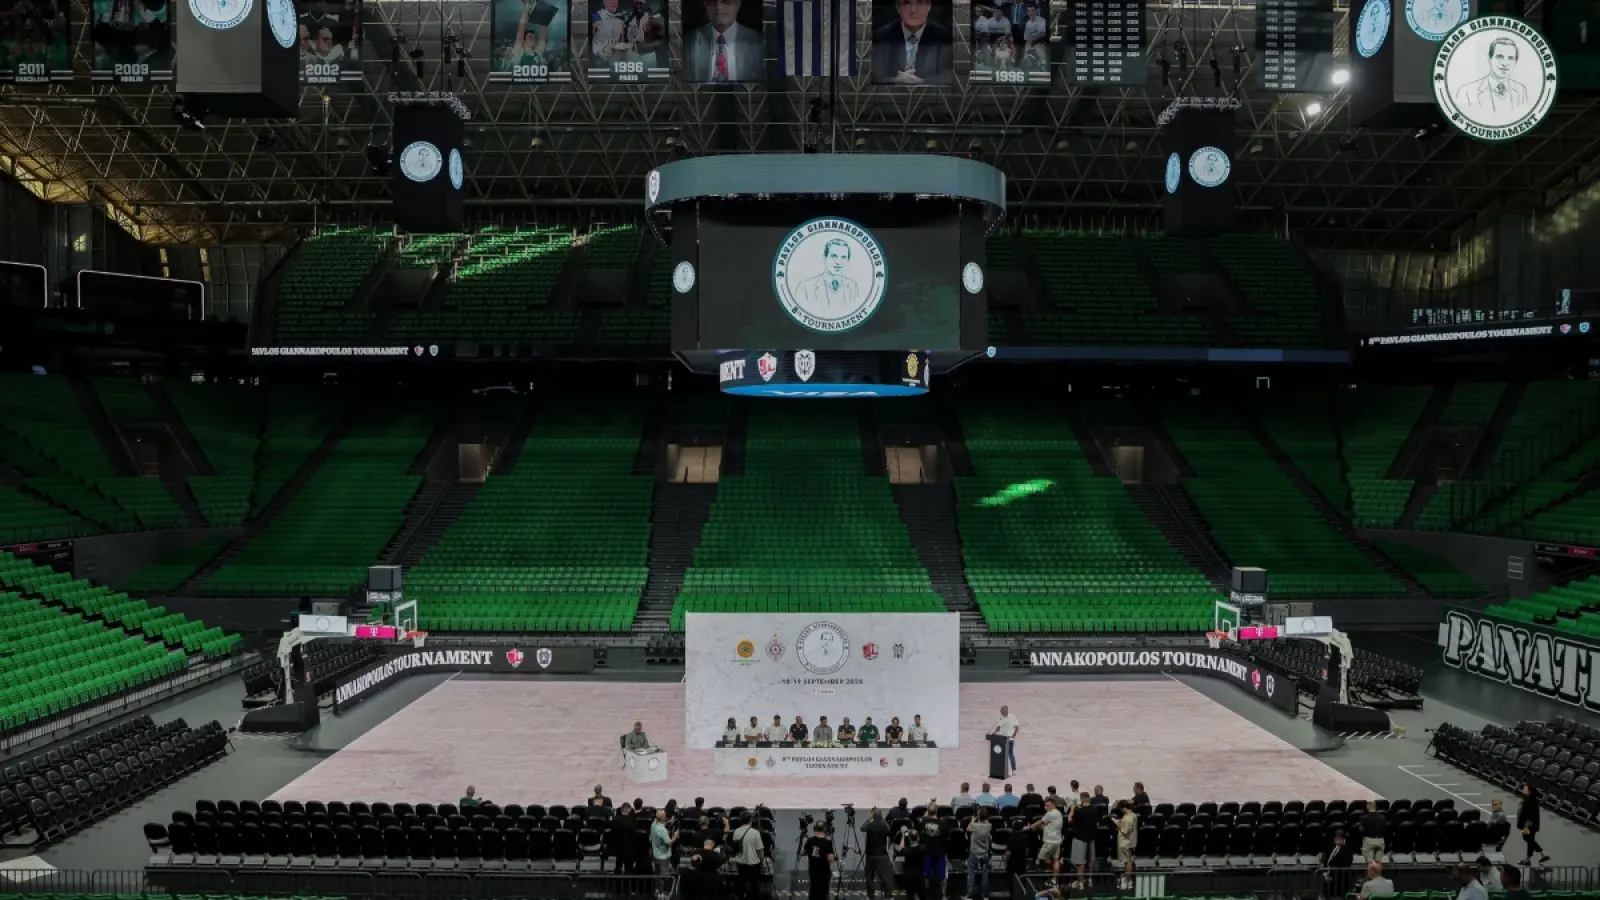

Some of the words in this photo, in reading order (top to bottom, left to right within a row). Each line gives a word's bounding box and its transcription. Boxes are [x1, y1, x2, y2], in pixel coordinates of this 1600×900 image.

[18, 64, 45, 75] 2011
[114, 64, 148, 75] 2009
[305, 64, 339, 75] 2002
[513, 65, 548, 76] 2000
[614, 62, 644, 73] 1996
[996, 71, 1024, 82] 1996
[778, 232, 804, 266] PAVLOS
[808, 221, 882, 267] GIANNAKOPOULOS
[803, 308, 869, 330] TOURNAMENT
[1380, 335, 1410, 344] PAVLOS
[1488, 326, 1552, 337] TOURNAMENT
[353, 347, 408, 355] TOURNAMENT
[393, 650, 493, 673] TOURNAMENT
[1030, 652, 1160, 666] ANNAKOPOULOS
[1162, 652, 1247, 681] TOURNAMENT
